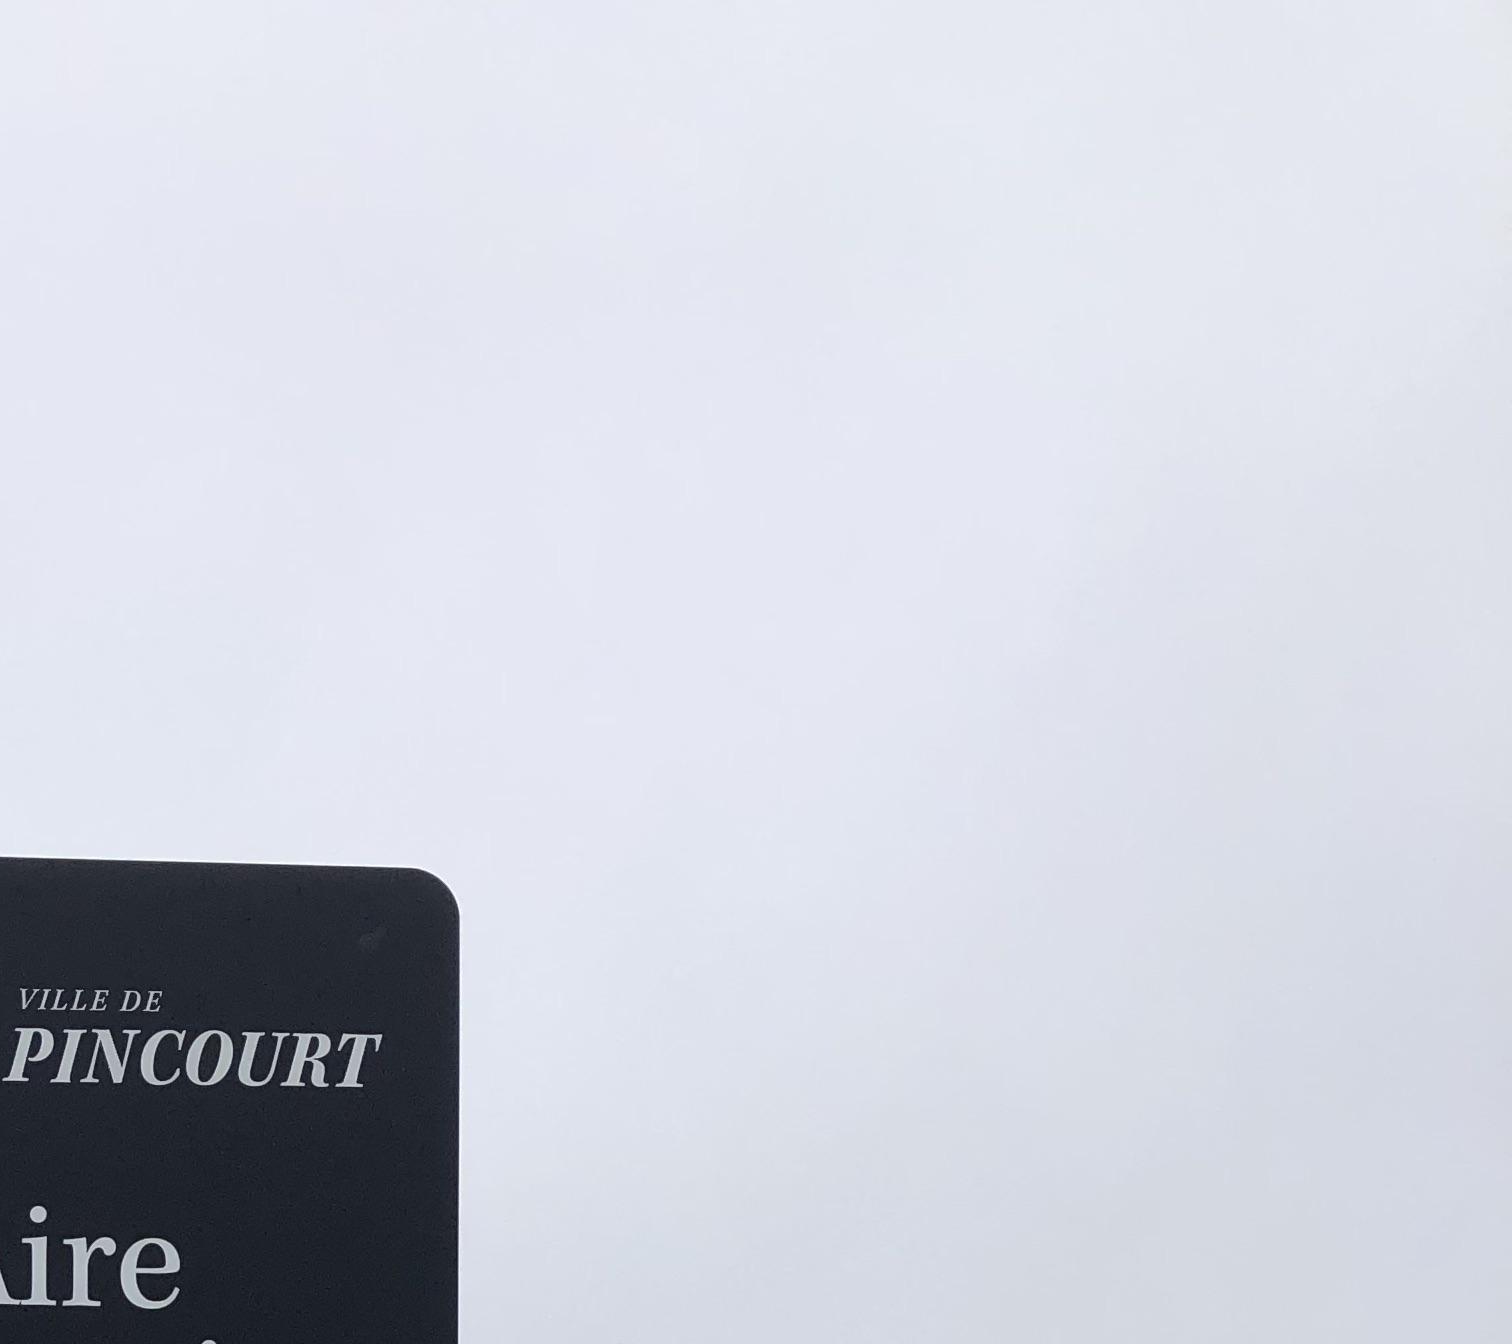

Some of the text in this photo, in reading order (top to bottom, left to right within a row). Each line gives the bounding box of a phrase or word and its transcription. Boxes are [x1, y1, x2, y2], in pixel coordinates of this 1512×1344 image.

[19, 987, 163, 1013] VILLE DE
[1, 1027, 383, 1088] PINCOURT
